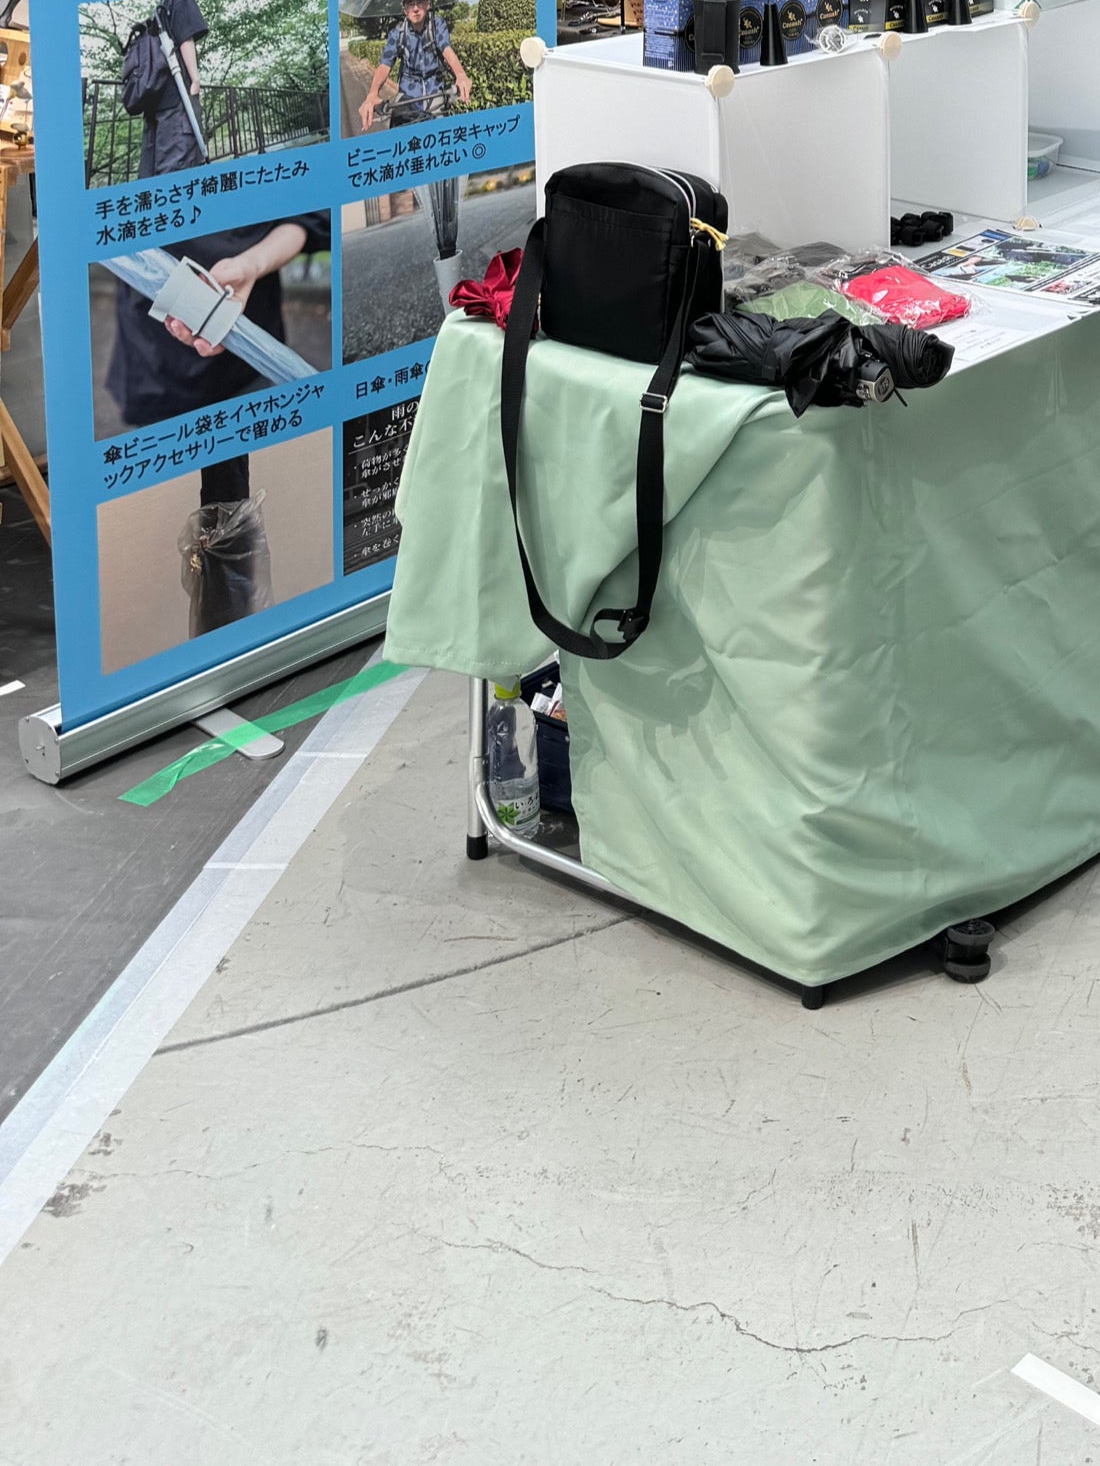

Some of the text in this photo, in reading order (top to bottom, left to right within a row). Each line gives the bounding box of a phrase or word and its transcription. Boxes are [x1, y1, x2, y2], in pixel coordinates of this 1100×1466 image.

[346, 115, 521, 168] ビニール傘の石突キャップ
[94, 161, 310, 221] 手を濡らさず綺麗にたたみ
[355, 360, 430, 400] 日傘・雨傘
[103, 382, 325, 466] 傘ビニール袋をイヤホンジャ
[103, 409, 303, 490] ックアクセサリーで留める
[353, 414, 417, 449] こんな不
